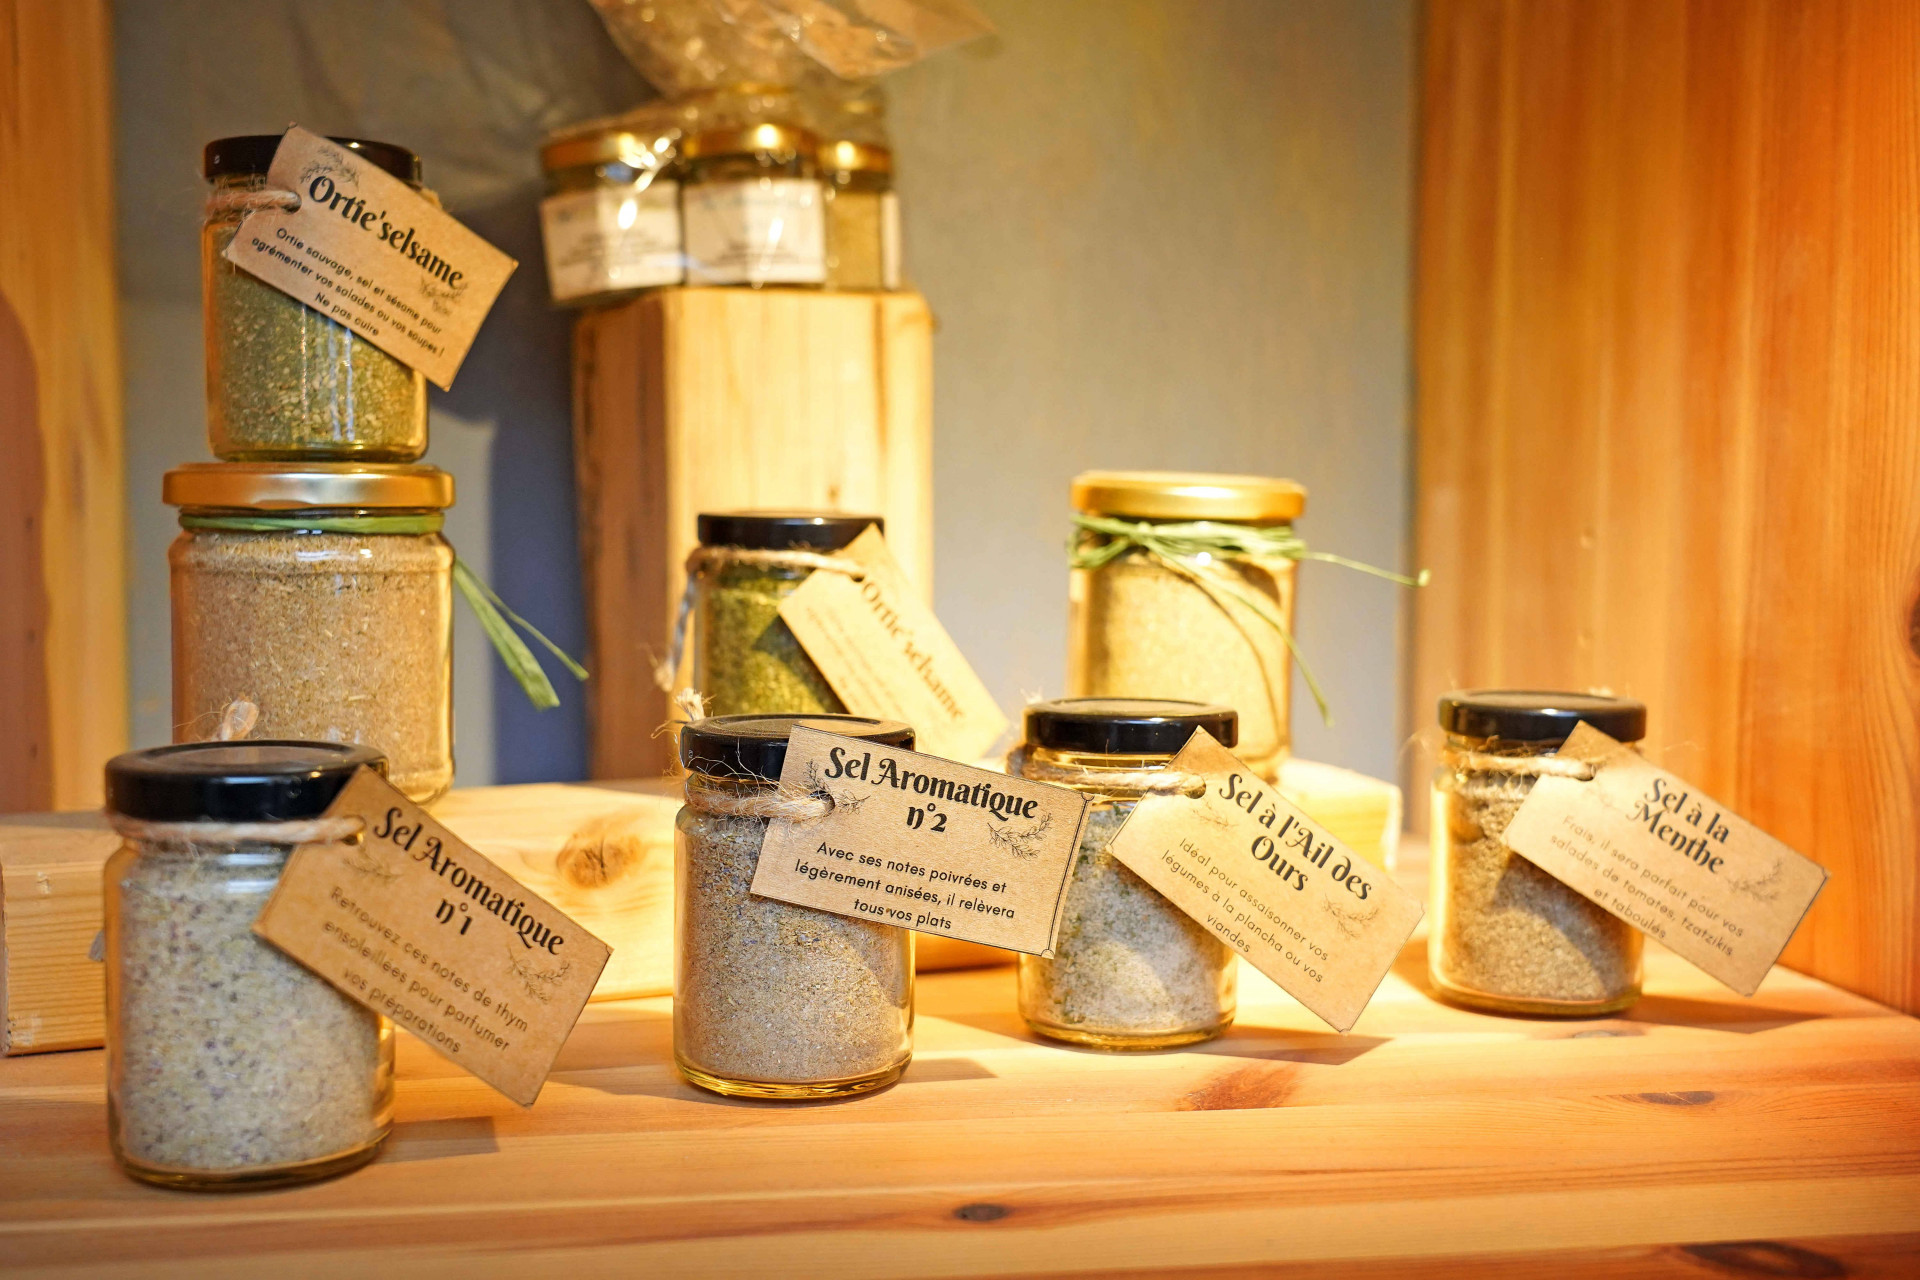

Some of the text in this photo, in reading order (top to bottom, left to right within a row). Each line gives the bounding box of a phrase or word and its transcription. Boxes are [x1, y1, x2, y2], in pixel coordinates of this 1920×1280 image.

[309, 175, 463, 289] Ortie'selsame
[251, 237, 313, 276] agrémenter
[316, 272, 332, 288] vos
[335, 284, 375, 314] salades
[377, 307, 389, 321] ou
[391, 316, 406, 333] vos
[276, 227, 442, 334] Ortie sauvage, sel et sésame pour
[315, 292, 379, 336] Ne pas cuire
[824, 747, 1038, 822] Sel Aromatique
[1644, 777, 1730, 844] Sel à la
[374, 807, 565, 956] Sel Aromatique
[817, 842, 1007, 893] Avec ses notes poivrées et
[1219, 773, 1372, 900] Sel à l'Ail des
[1251, 835, 1308, 891] Ours
[1562, 815, 1744, 938] Frais, il sera parfait pour vos
[1626, 800, 1725, 875] Menthe
[795, 859, 1014, 919] légèrement anisées, il relèvera
[853, 898, 951, 929] tous vos plats
[1161, 850, 1323, 983] légumes à la plancha ou vos
[1179, 838, 1329, 961] Idéal pour assaisonner vos
[1206, 914, 1250, 953] viandes
[1551, 834, 1733, 957] salades de tomates, tzatzikis
[1593, 888, 1666, 940] et taboulés
[323, 919, 510, 1053] ensoleillées pour parfumer
[331, 886, 529, 1032] Retrouvez ces notes de thym
[343, 968, 462, 1053] vos préparations
